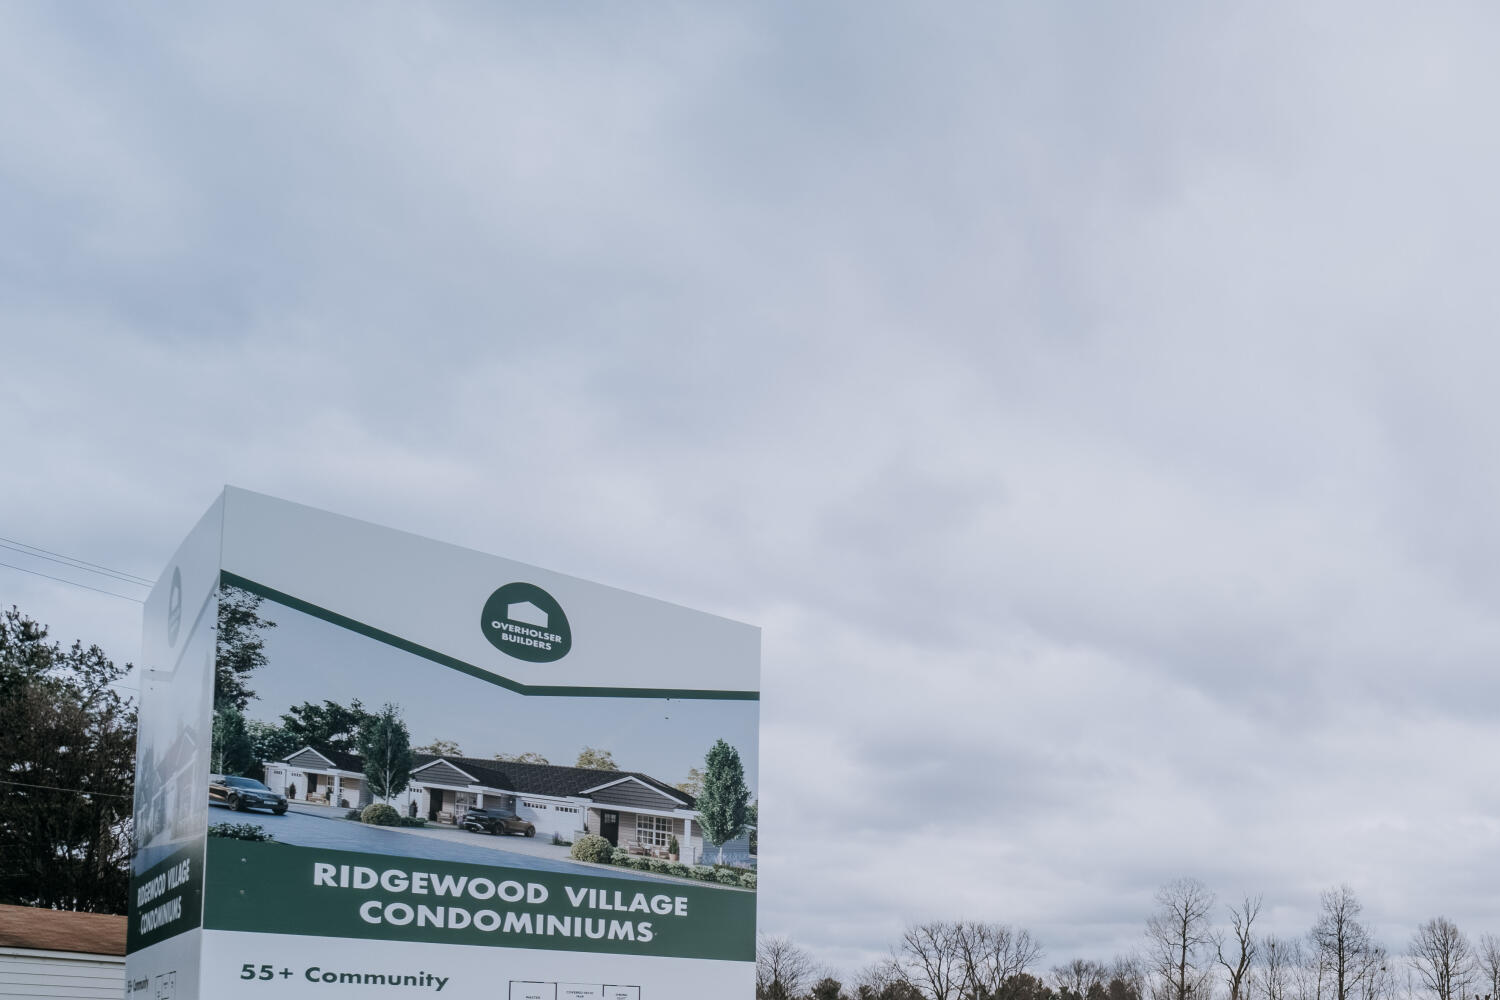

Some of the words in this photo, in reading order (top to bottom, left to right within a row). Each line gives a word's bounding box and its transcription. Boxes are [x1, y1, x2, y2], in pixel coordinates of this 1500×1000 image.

[491, 620, 562, 643] OVERHOLSER
[501, 632, 552, 651] BUILDERS
[313, 862, 549, 904] RIDGEWOOD
[564, 886, 688, 917] VILLAGE
[359, 900, 654, 943] CONDOMINIUMS
[240, 963, 294, 981] 55+
[305, 966, 449, 991] Community
